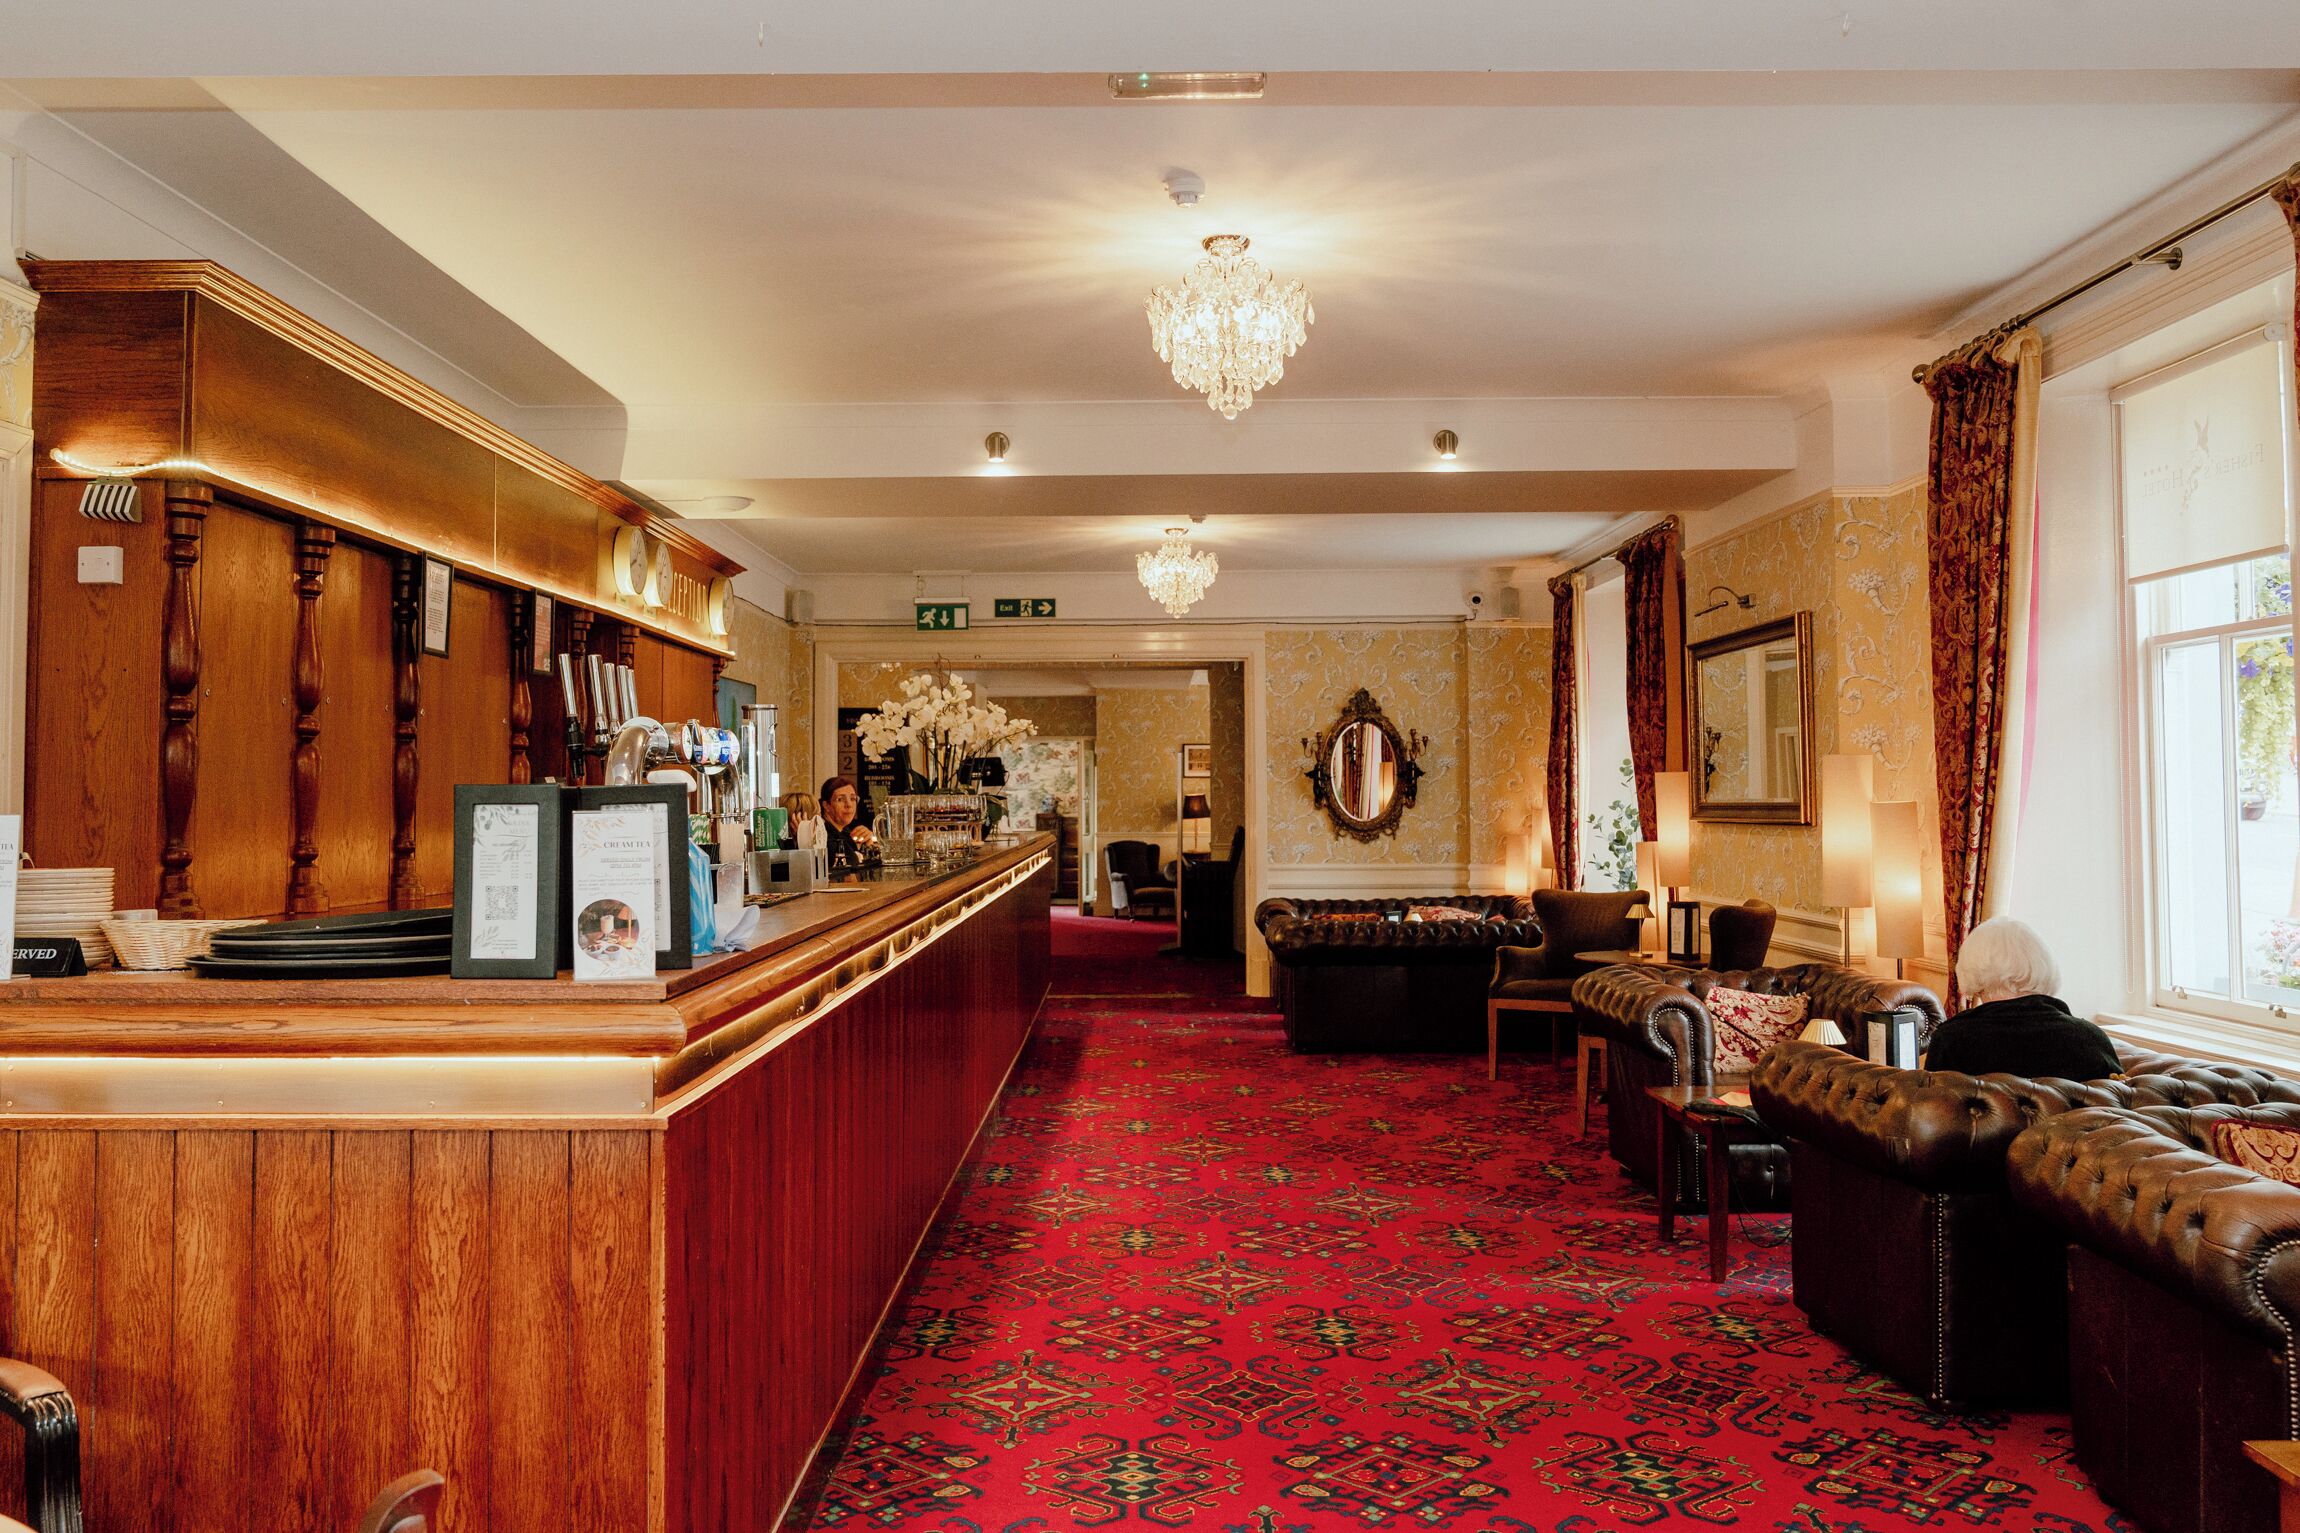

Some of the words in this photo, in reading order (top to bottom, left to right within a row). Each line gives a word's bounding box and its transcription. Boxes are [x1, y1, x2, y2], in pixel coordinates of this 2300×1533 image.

[663, 571, 708, 623] CEPTION
[1000, 604, 1013, 612] Exit
[603, 841, 634, 849] CREAM
[636, 841, 651, 849] TEA
[12, 948, 57, 959] ERVED
